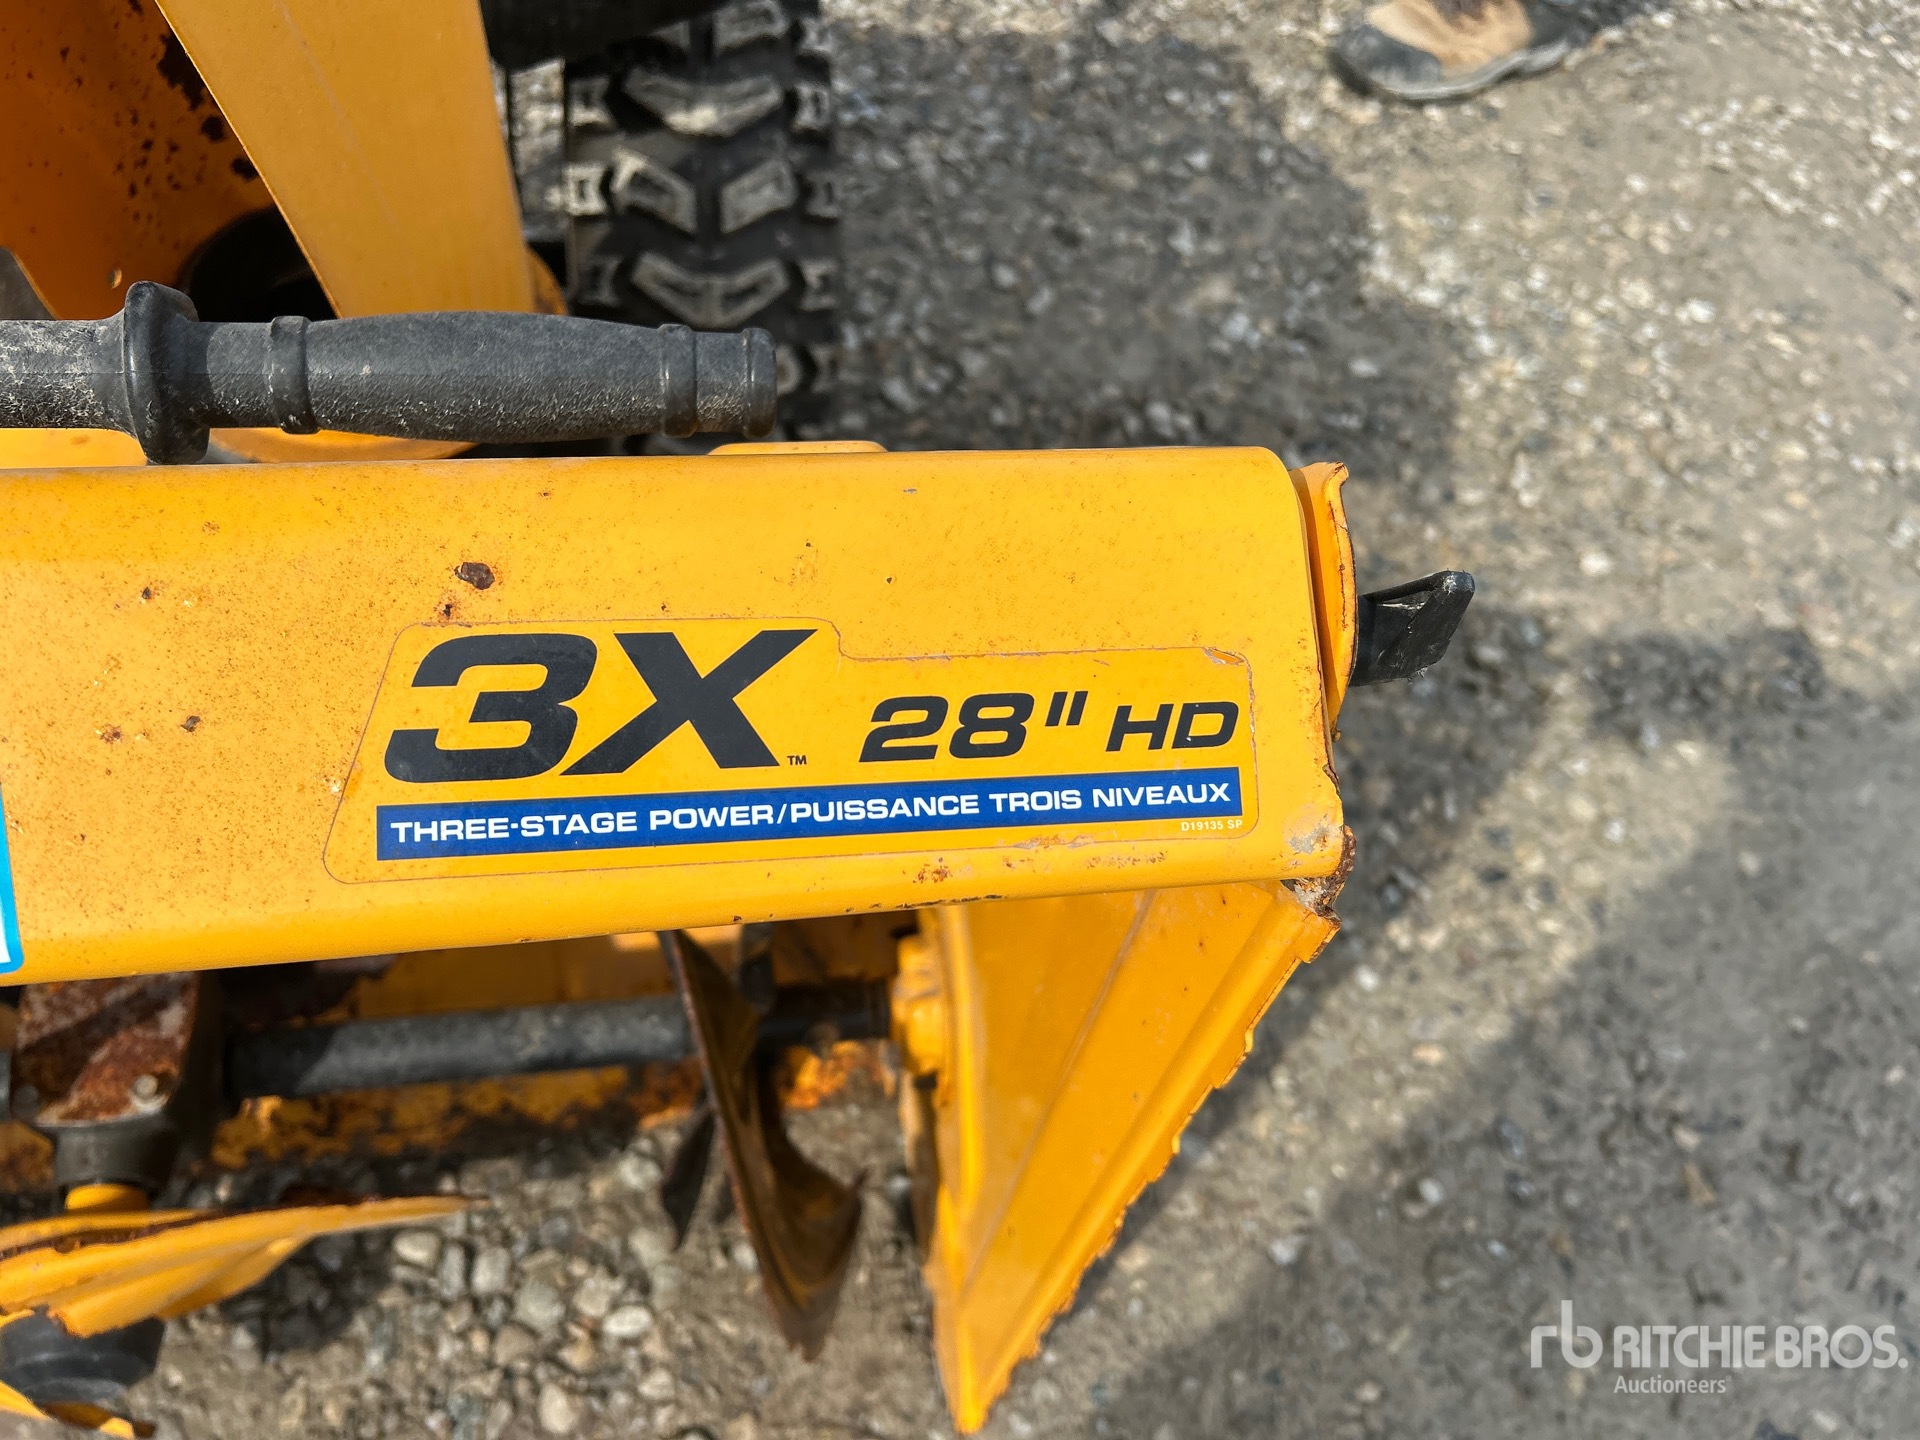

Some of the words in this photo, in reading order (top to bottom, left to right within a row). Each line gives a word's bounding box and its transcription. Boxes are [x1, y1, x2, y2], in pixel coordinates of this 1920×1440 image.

[384, 629, 818, 783] 3X
[858, 690, 1088, 763] 28"
[1106, 701, 1239, 752] HD
[390, 812, 638, 843] THREE-STAGE
[649, 793, 980, 831] POWER/PUISSANCE
[988, 789, 1082, 813] TROIS
[1092, 782, 1231, 808] NIVEAUX
[1180, 820, 1224, 832] D19135
[1227, 819, 1243, 829] SP
